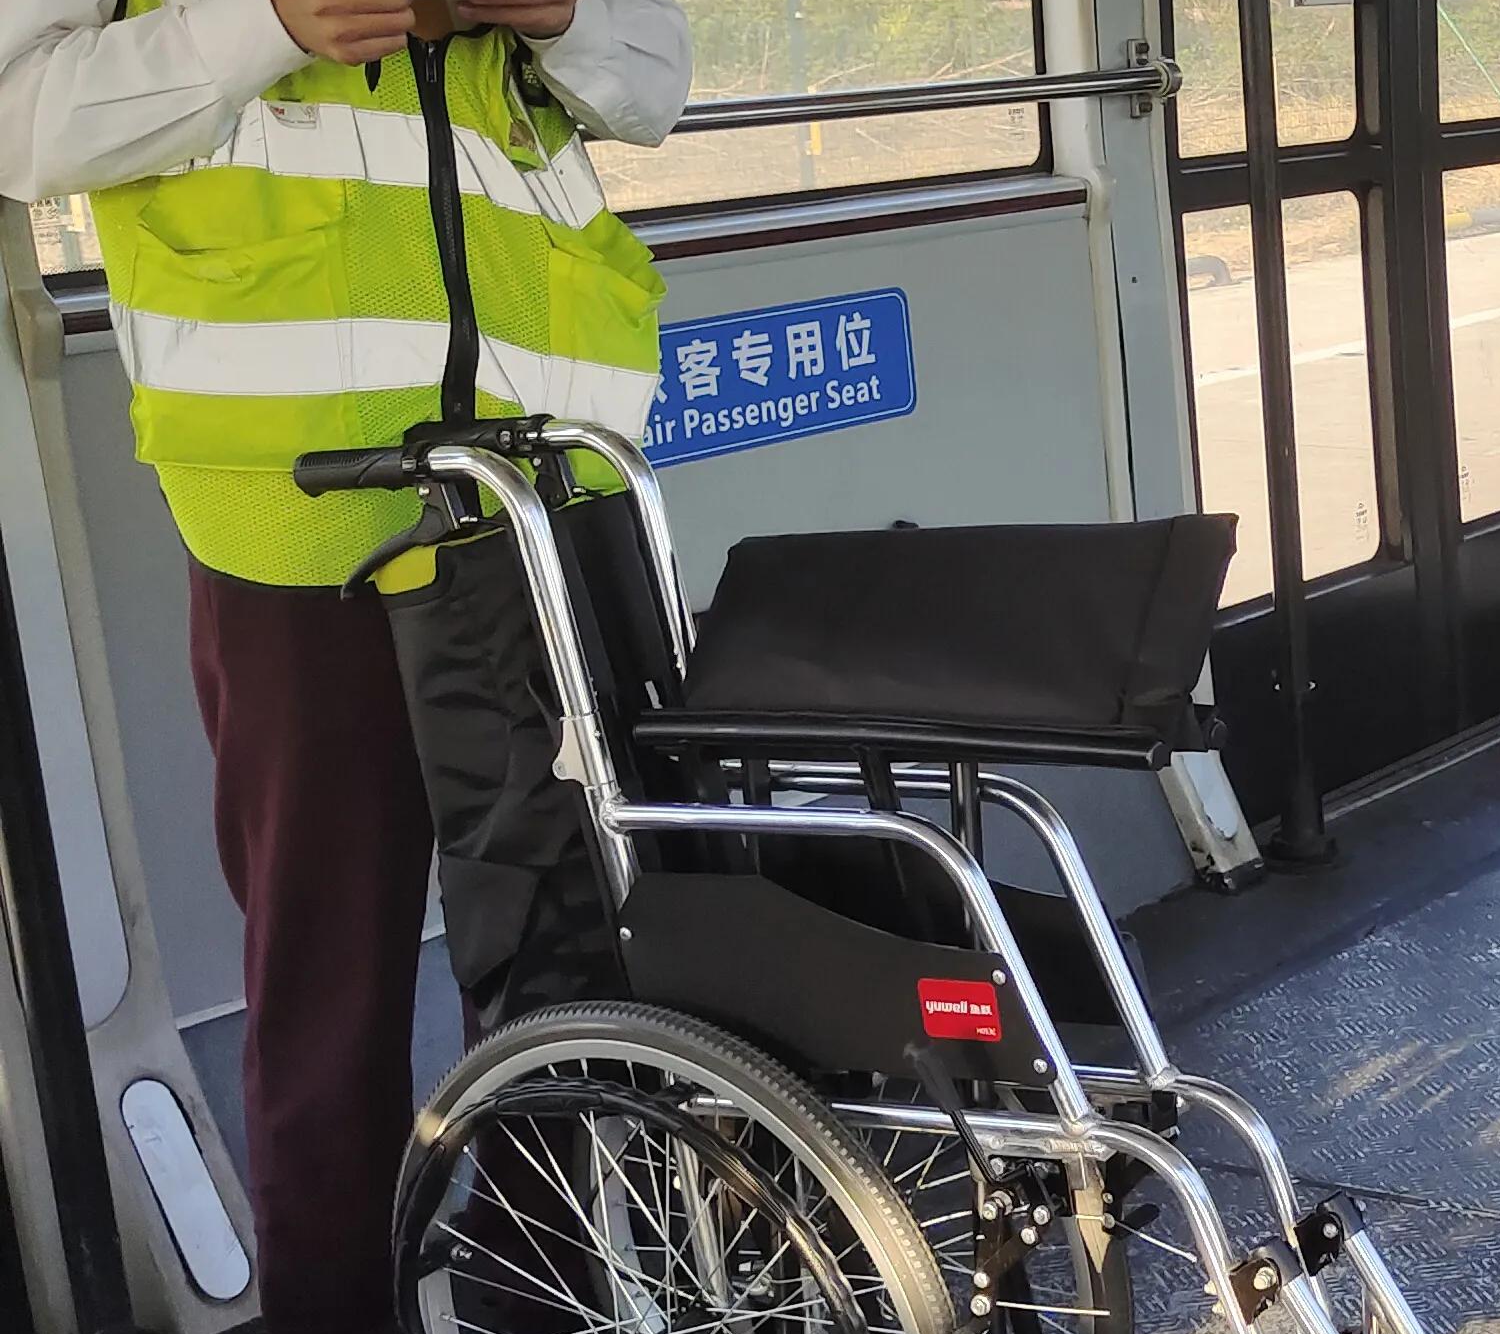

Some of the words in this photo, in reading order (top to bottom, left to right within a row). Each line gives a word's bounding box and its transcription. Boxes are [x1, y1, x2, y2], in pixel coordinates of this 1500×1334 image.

[683, 390, 821, 440] Passenger
[825, 374, 881, 411] Seat
[925, 1000, 968, 1015] yuwell
